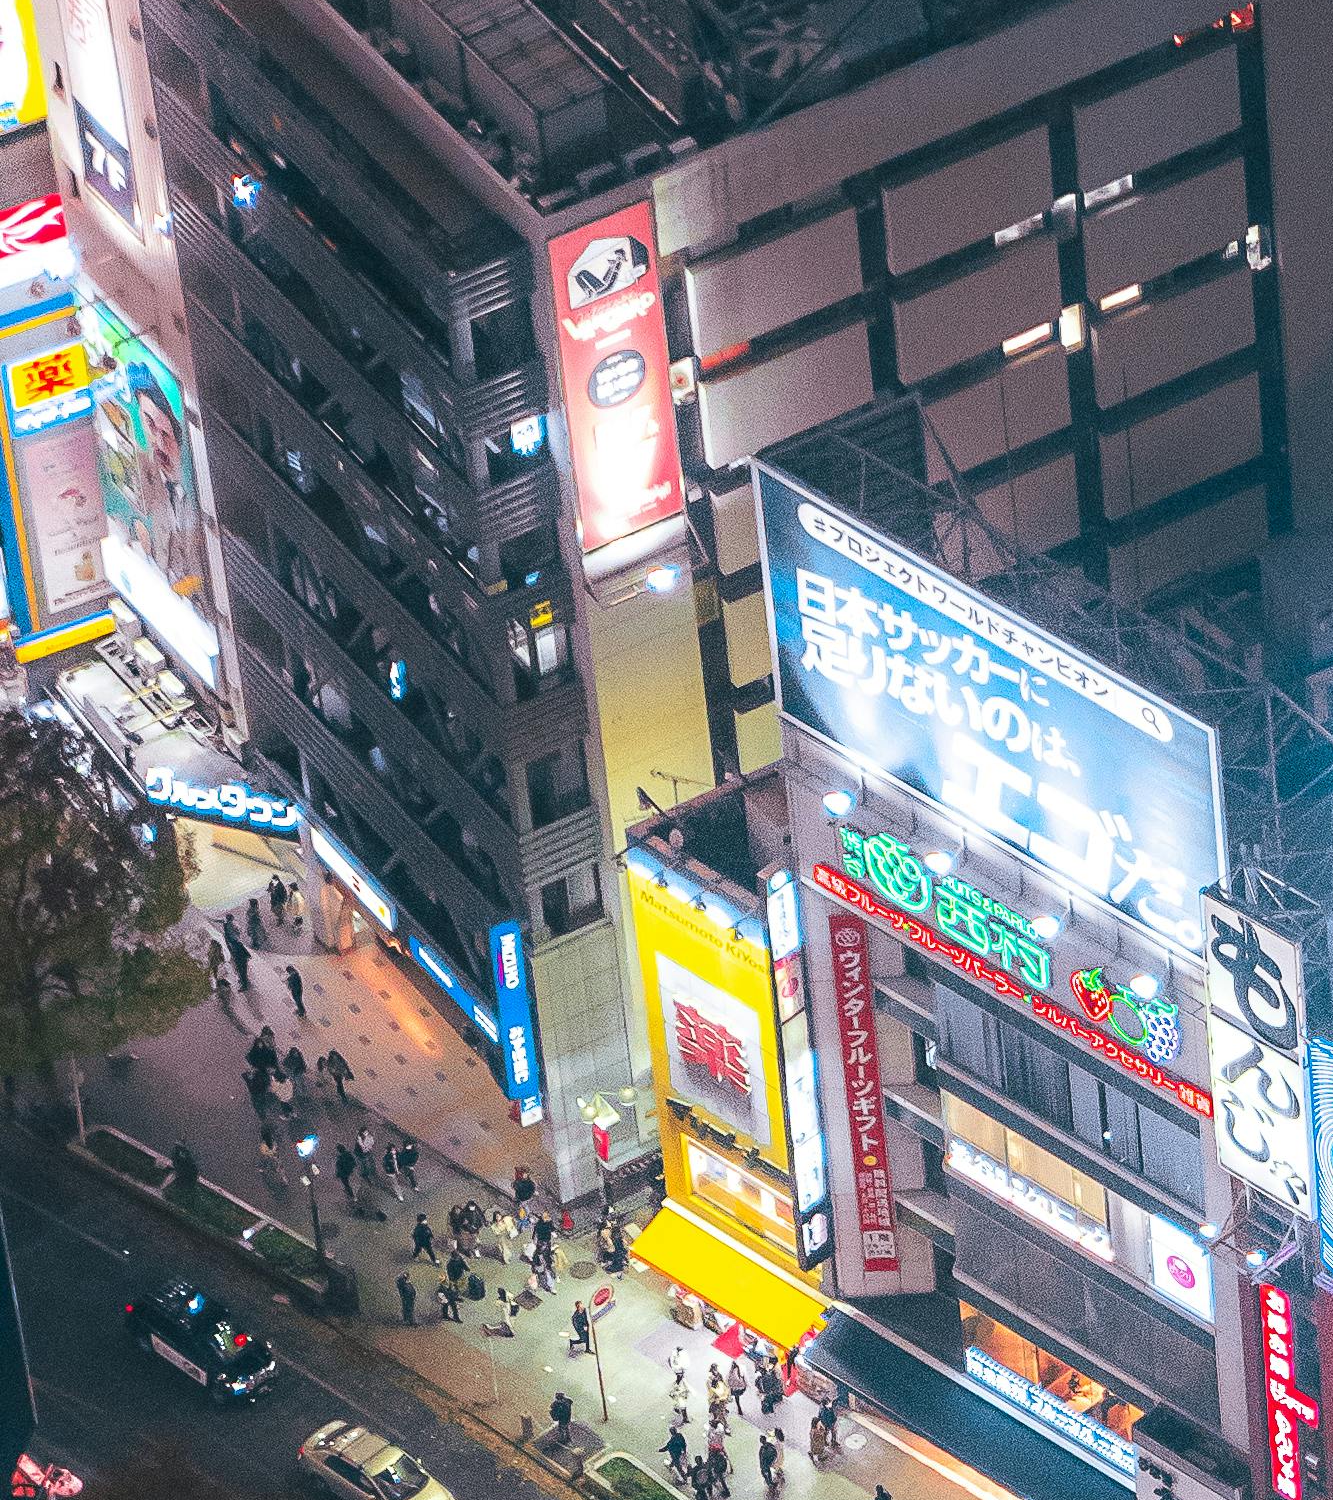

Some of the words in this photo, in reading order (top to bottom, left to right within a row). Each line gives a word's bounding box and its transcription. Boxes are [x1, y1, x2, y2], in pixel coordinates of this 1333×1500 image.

[23, 353, 74, 401] 薬
[796, 566, 1052, 709] 日本サッカーに
[146, 766, 301, 832] グルメタウン
[499, 931, 520, 990] MIZUHO
[638, 889, 724, 950] Matsumoto
[934, 885, 1050, 991] 西村
[672, 997, 753, 1096] 薬
[836, 951, 880, 1153] ウィンターフルーツギフト
[1211, 912, 1309, 1207] もんじゃ
